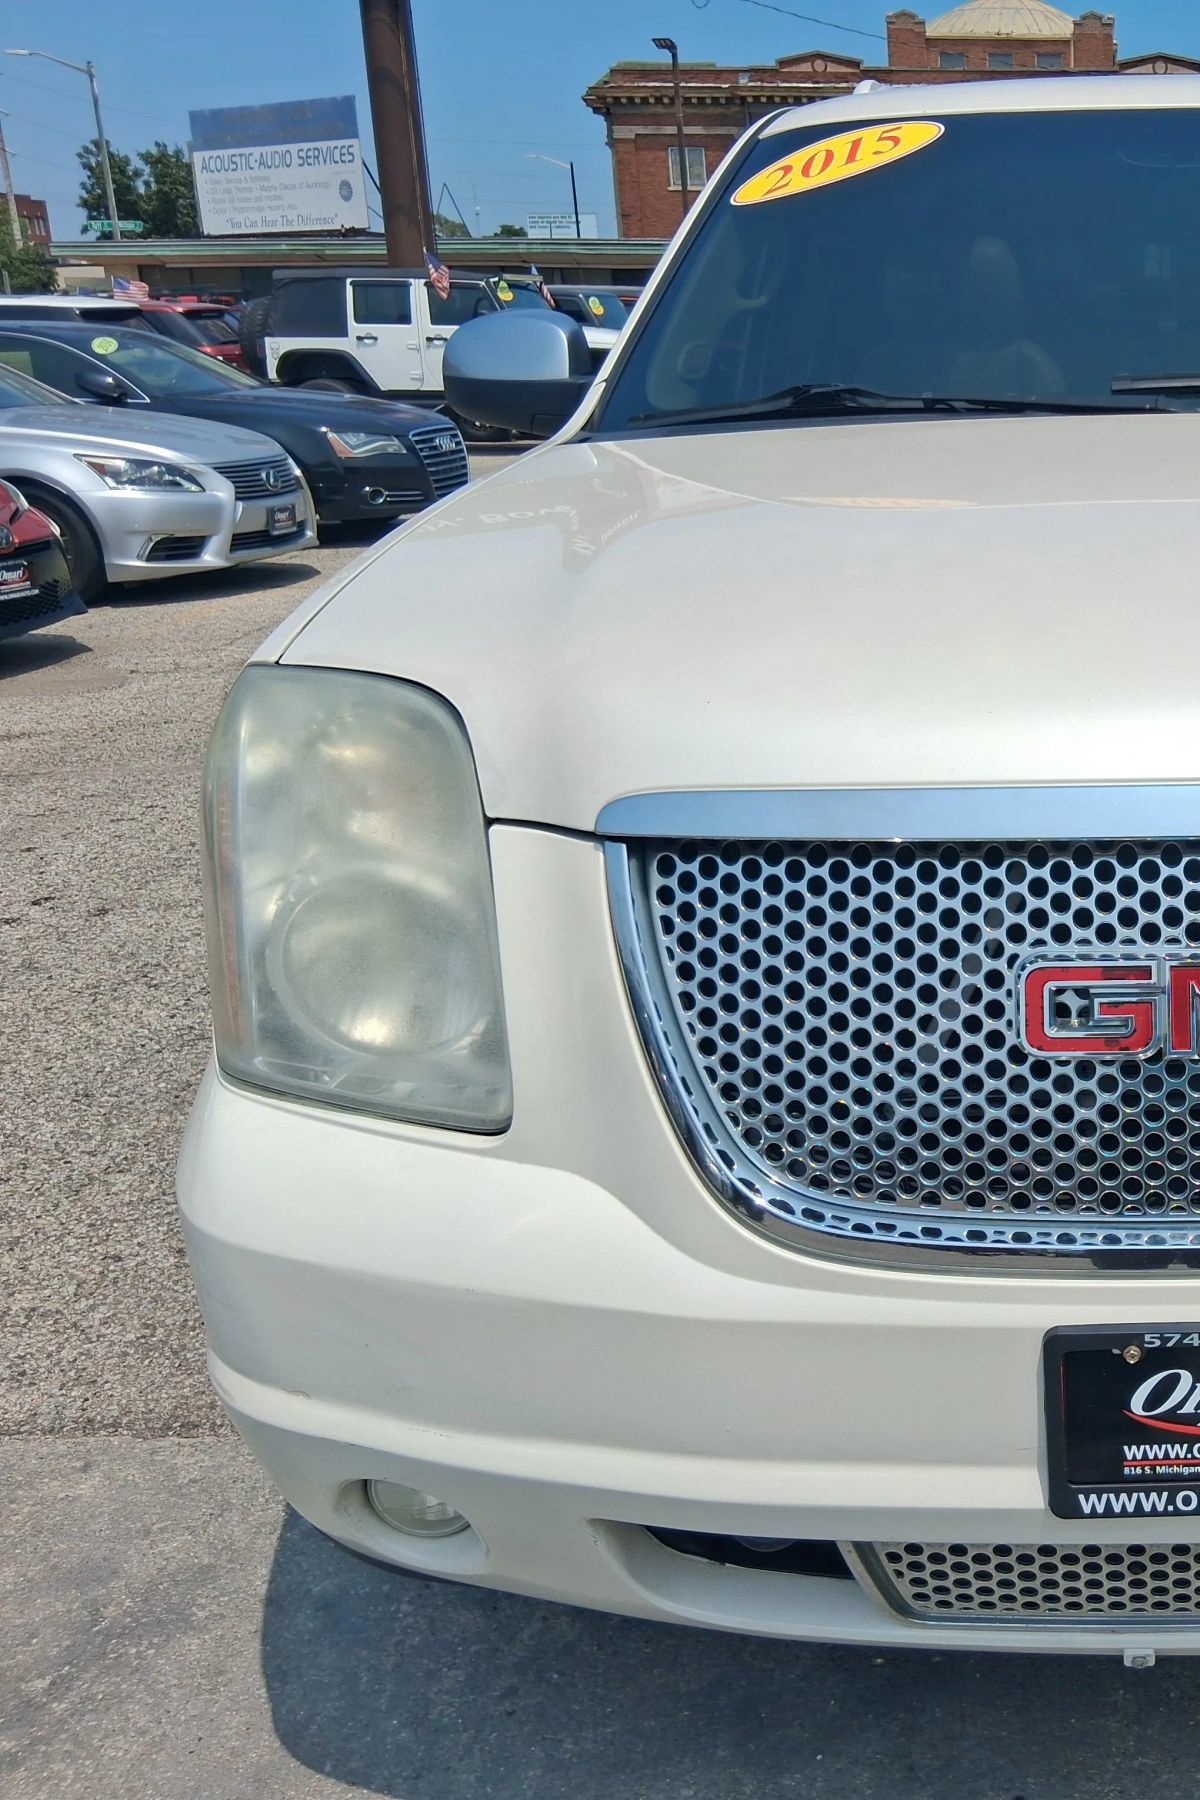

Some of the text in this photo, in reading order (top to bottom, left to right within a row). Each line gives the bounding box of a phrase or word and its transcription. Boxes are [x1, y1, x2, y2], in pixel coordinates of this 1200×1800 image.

[297, 144, 355, 168] SERVICES
[761, 126, 903, 197] 2015
[244, 216, 258, 228] Can
[261, 215, 277, 227] Hear
[280, 214, 294, 227] The
[1124, 1467, 1142, 1475] 816
[1156, 1464, 1200, 1475] Michigan
